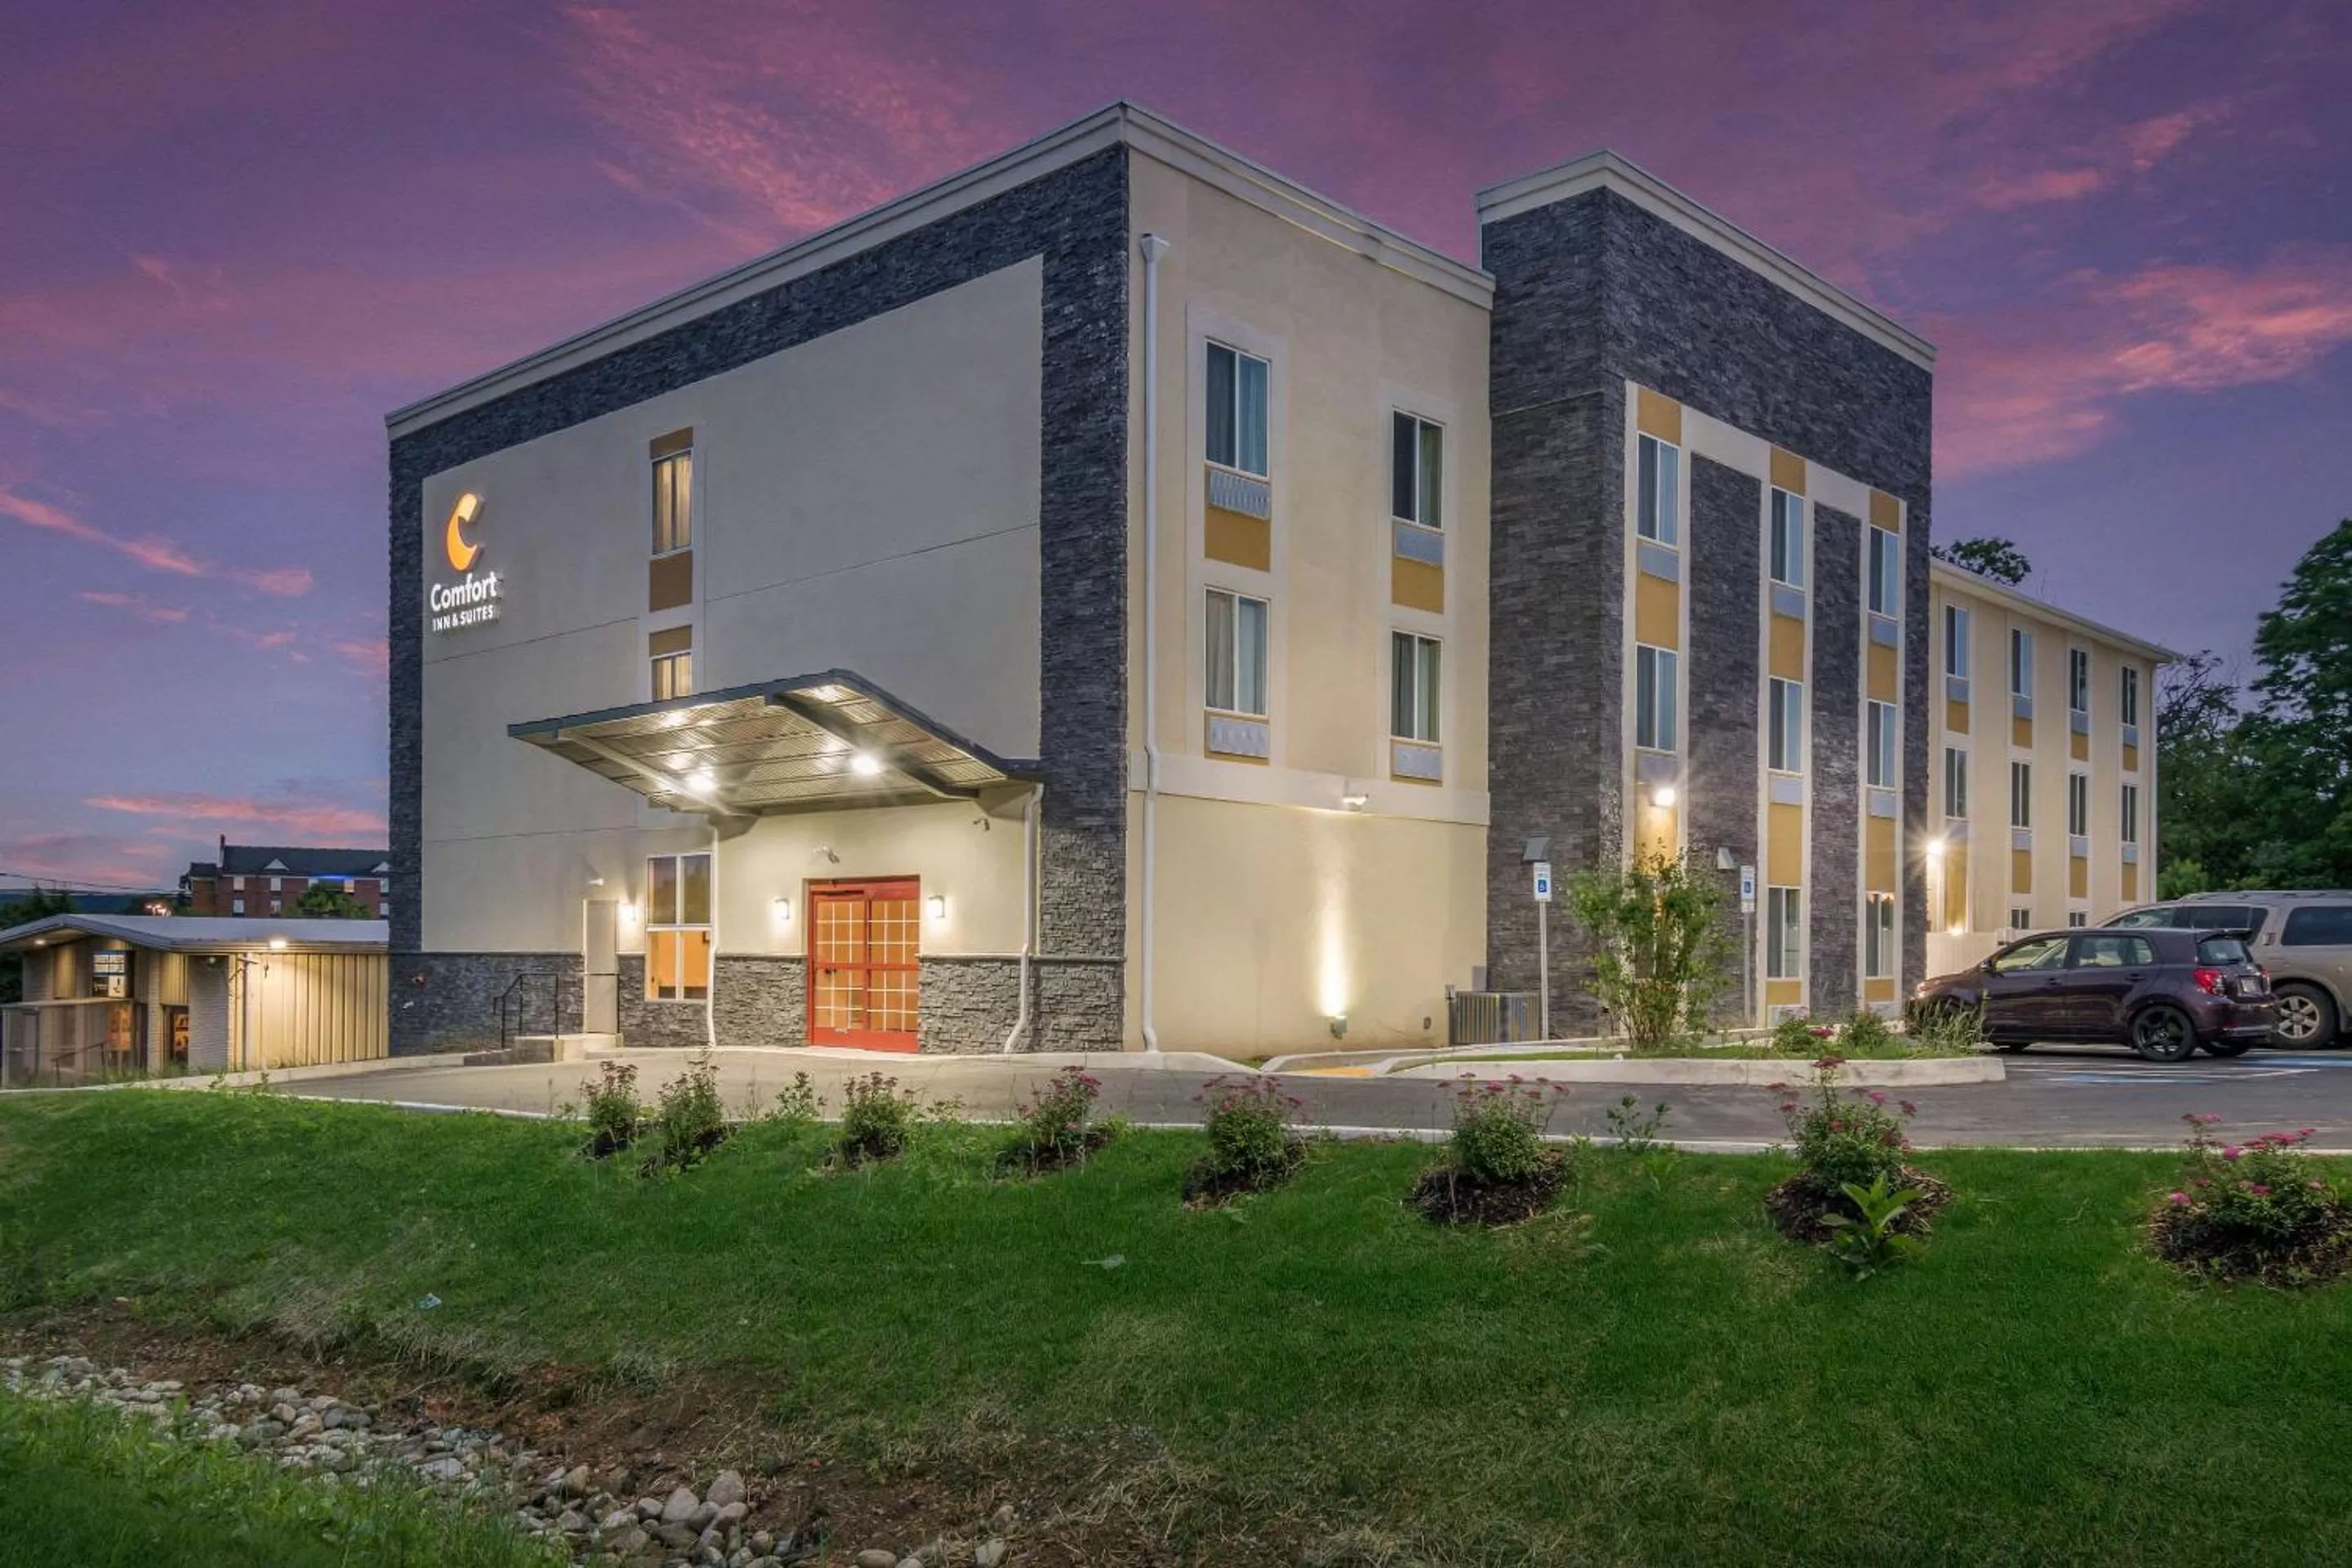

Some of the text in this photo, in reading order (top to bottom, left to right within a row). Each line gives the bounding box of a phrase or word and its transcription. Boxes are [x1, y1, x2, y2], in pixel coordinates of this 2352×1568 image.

[431, 571, 497, 611] Comfort
[432, 604, 493, 631] INN & SUITES
